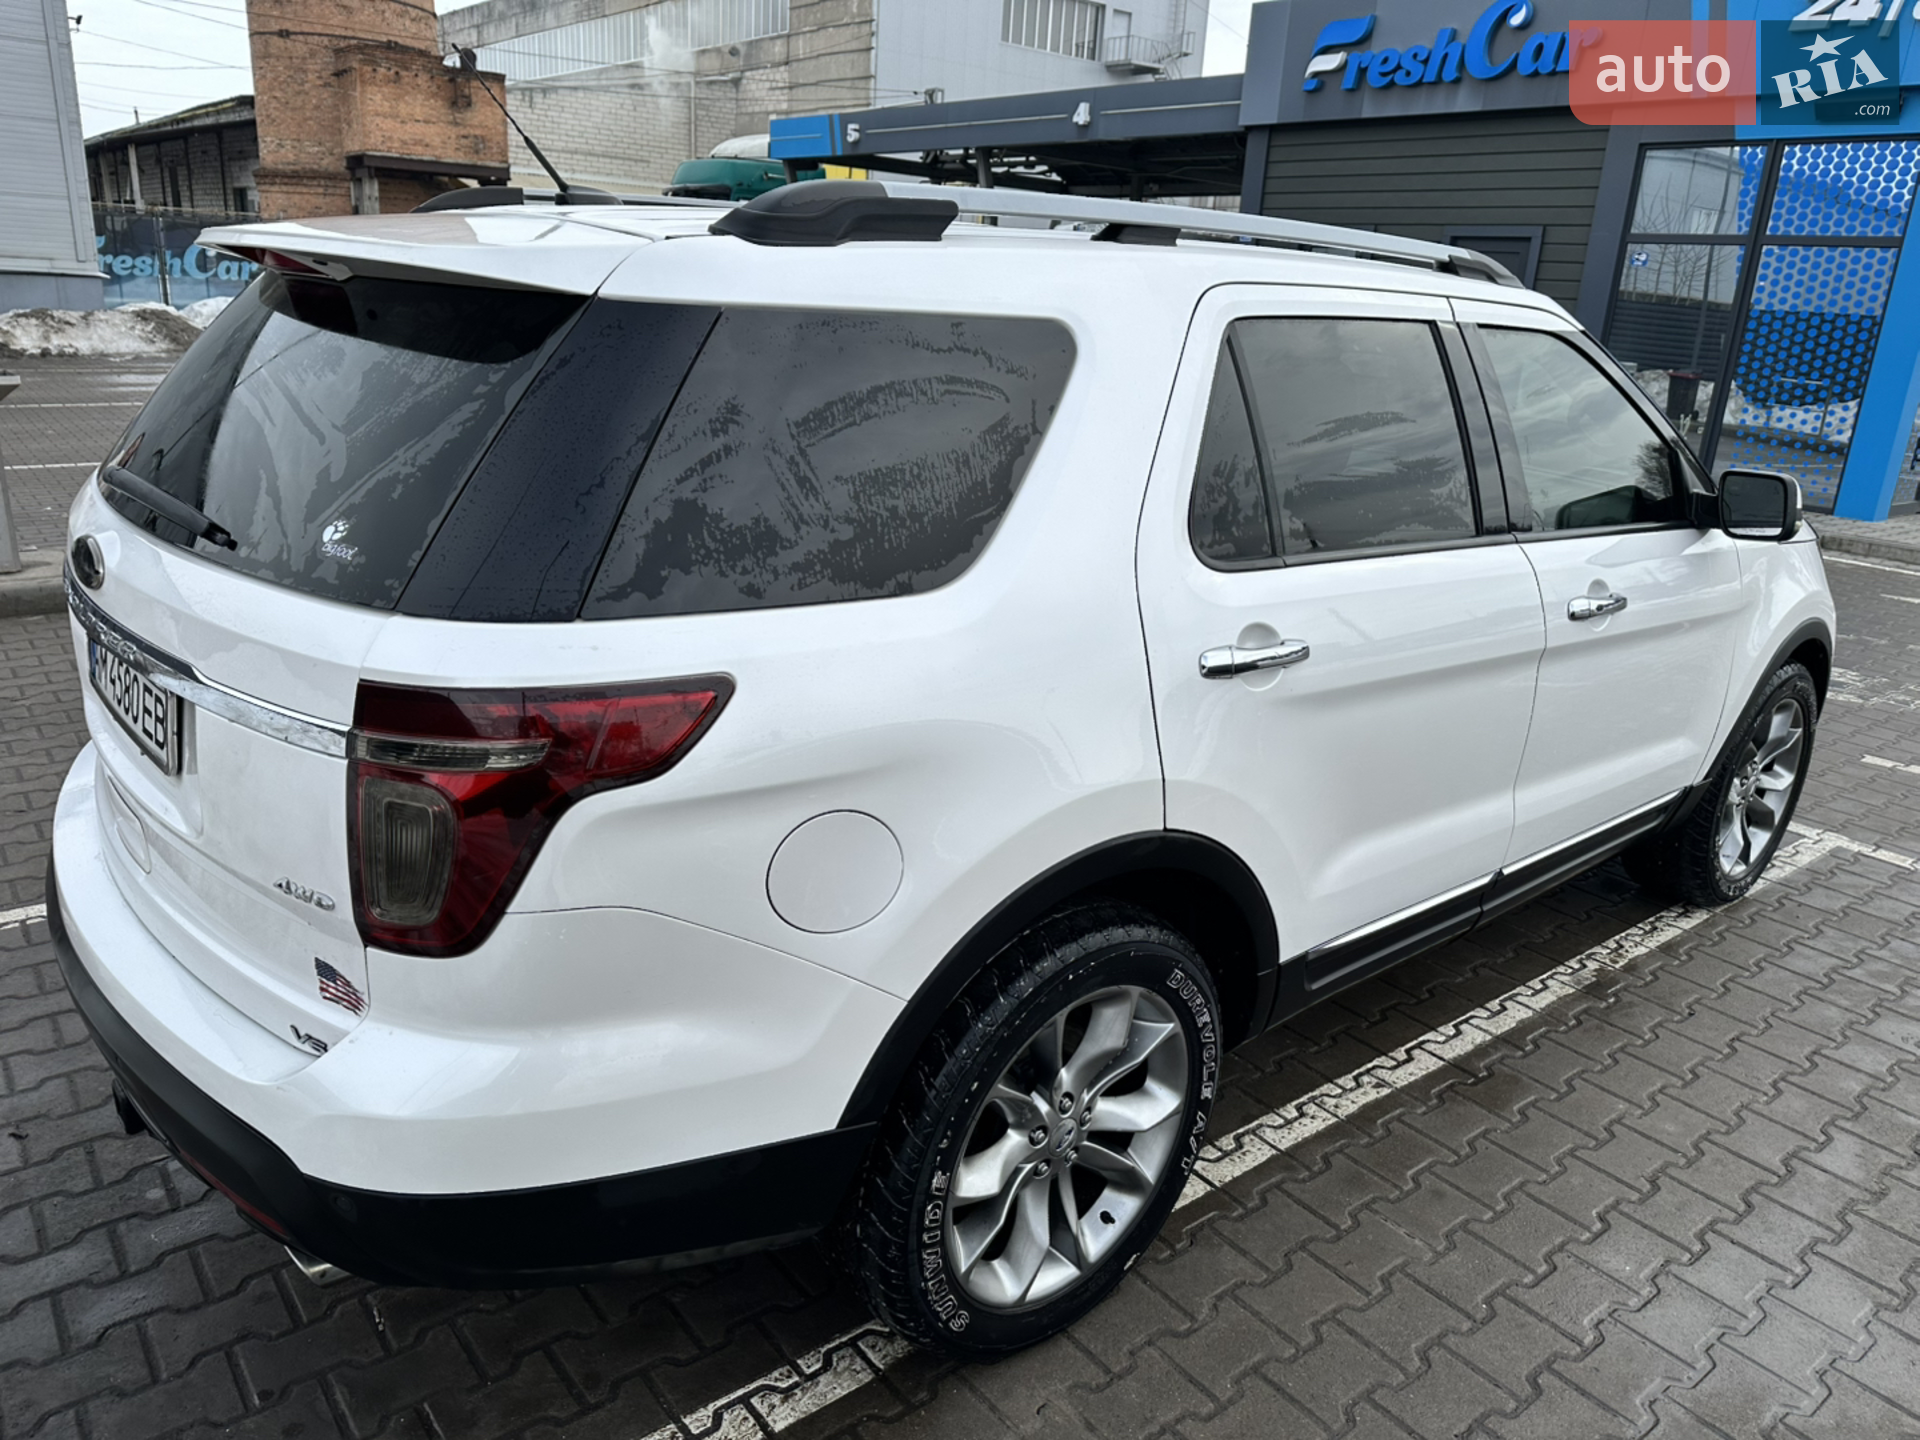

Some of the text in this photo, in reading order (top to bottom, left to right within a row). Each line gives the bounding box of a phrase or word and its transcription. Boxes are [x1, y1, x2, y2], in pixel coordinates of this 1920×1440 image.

[1303, 0, 1603, 91] FreshCar
[847, 123, 860, 143] 5
[1072, 102, 1091, 125] 4
[94, 235, 260, 281] reshCar
[142, 682, 165, 751] EB
[1166, 967, 1217, 1100] DUREVOLE
[921, 1170, 970, 1333] SUNWIDE
